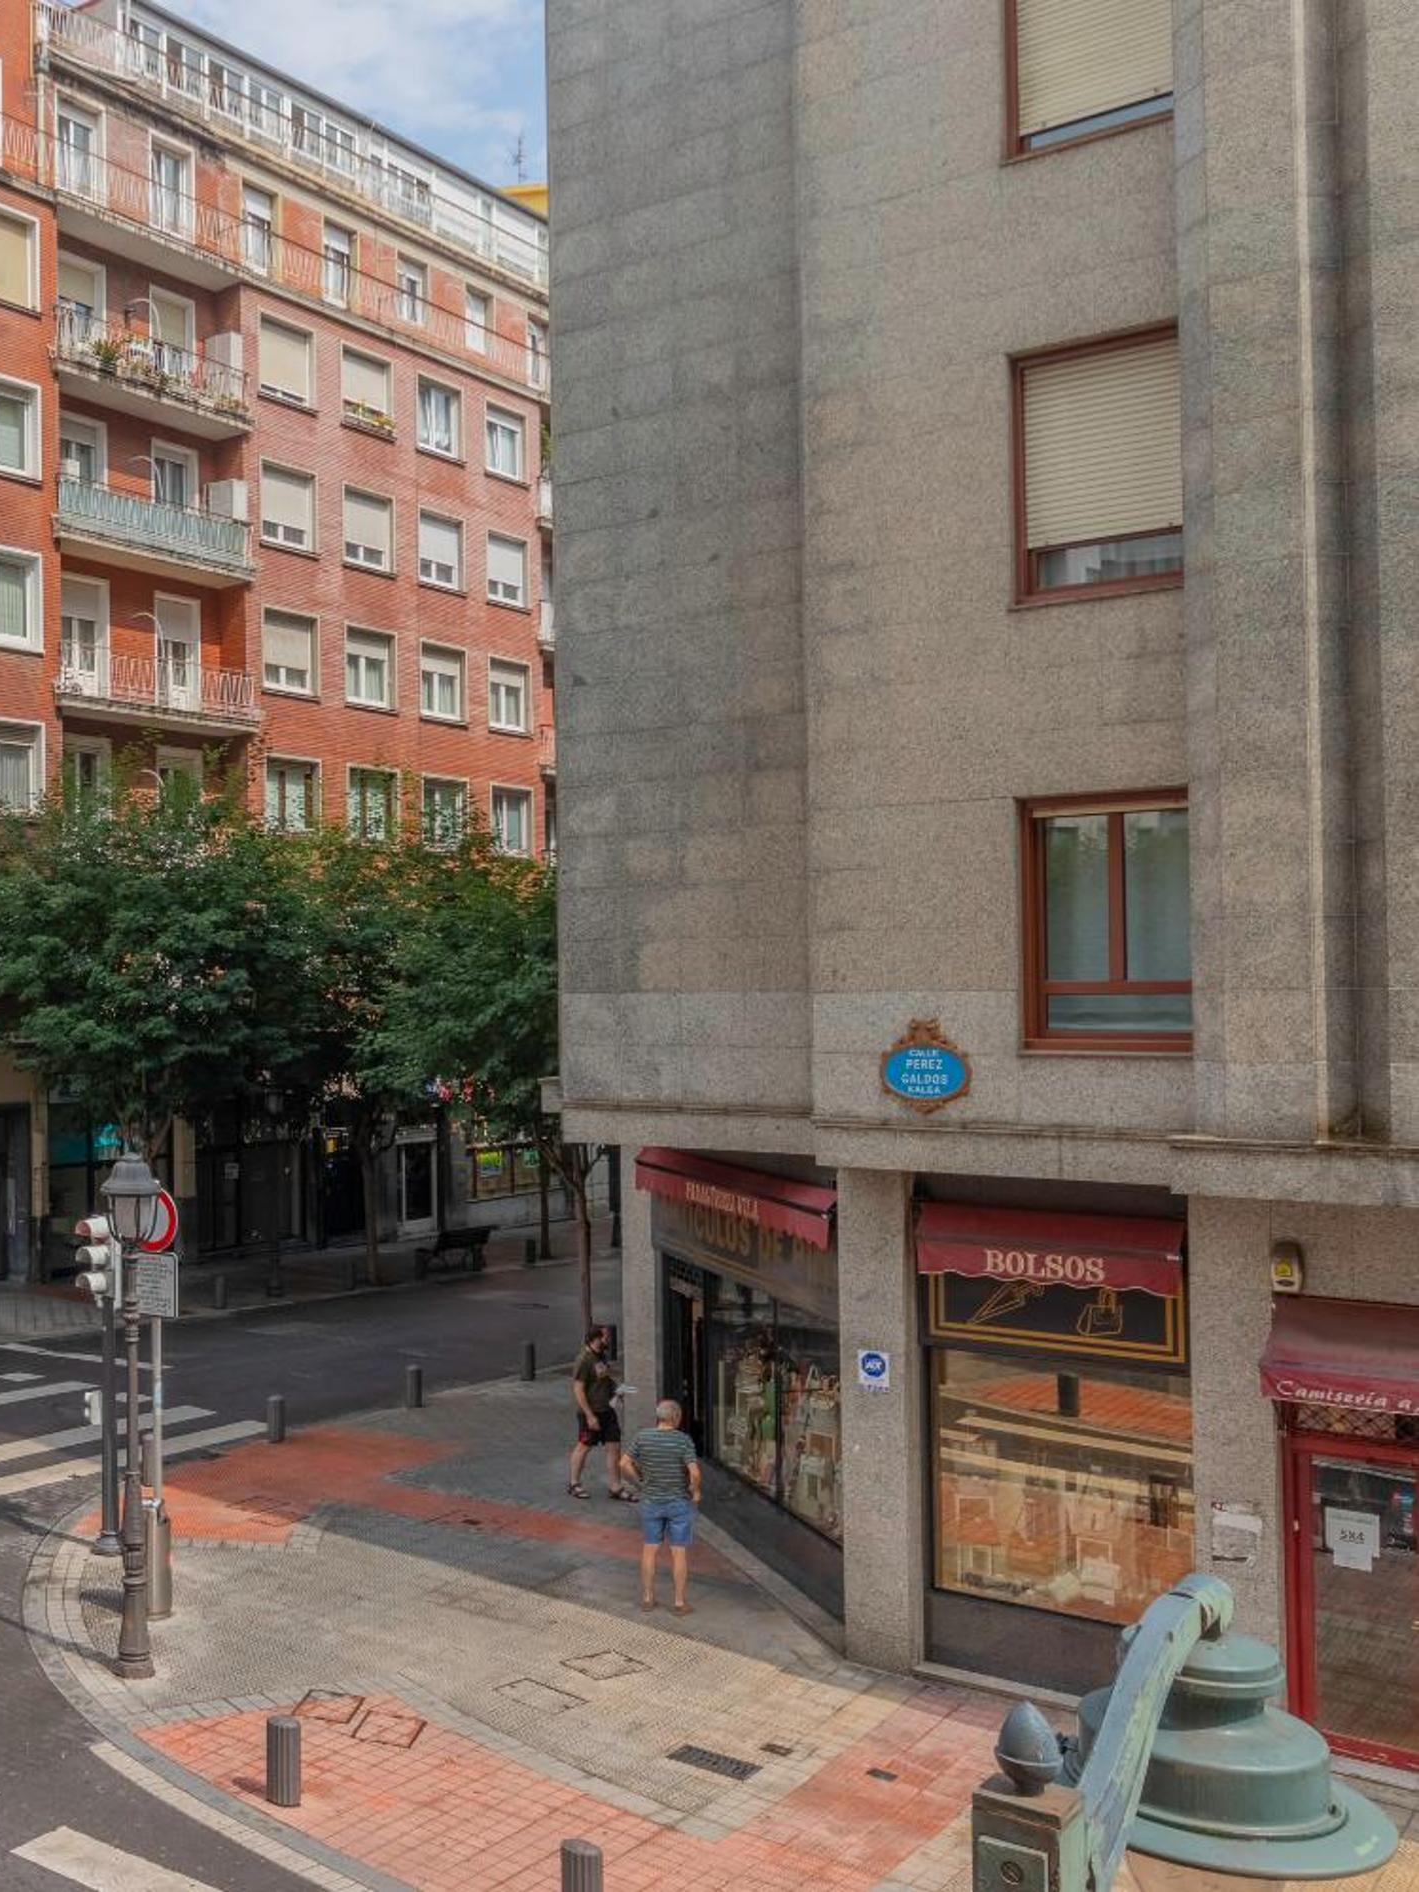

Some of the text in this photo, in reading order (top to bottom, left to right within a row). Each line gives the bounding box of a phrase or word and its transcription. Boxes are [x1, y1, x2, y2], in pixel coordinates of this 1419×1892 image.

[908, 1048, 940, 1057] CALLE
[905, 1059, 943, 1070] PEREZ
[900, 1073, 950, 1085] GALDOS
[907, 1086, 942, 1096] KALEA
[984, 1249, 1106, 1282] BOLSOS
